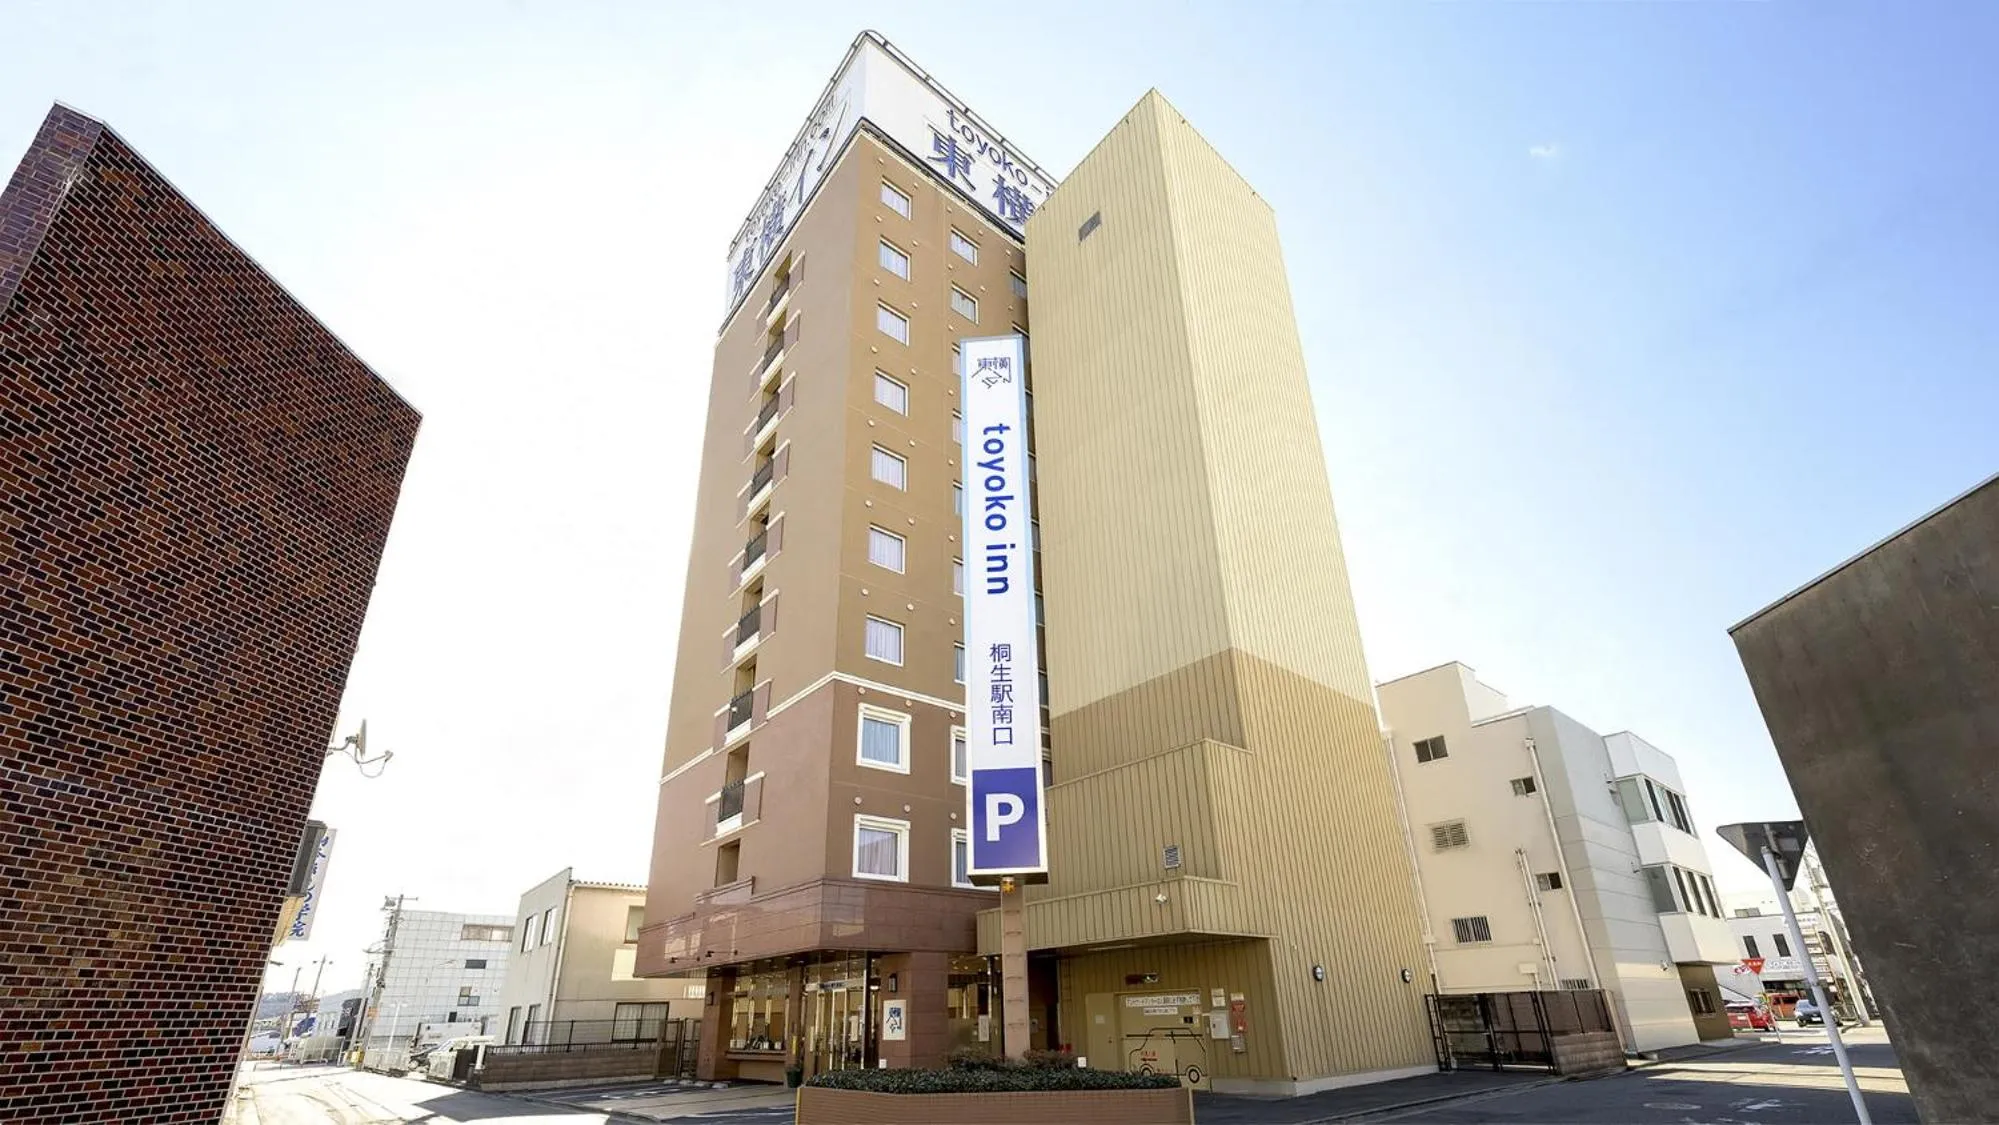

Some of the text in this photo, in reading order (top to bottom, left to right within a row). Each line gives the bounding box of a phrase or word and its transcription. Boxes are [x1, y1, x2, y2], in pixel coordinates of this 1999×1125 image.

[977, 423, 1016, 594] toyoko inn
[989, 643, 1014, 746] 桐生駅南口
[985, 793, 1025, 841] P
